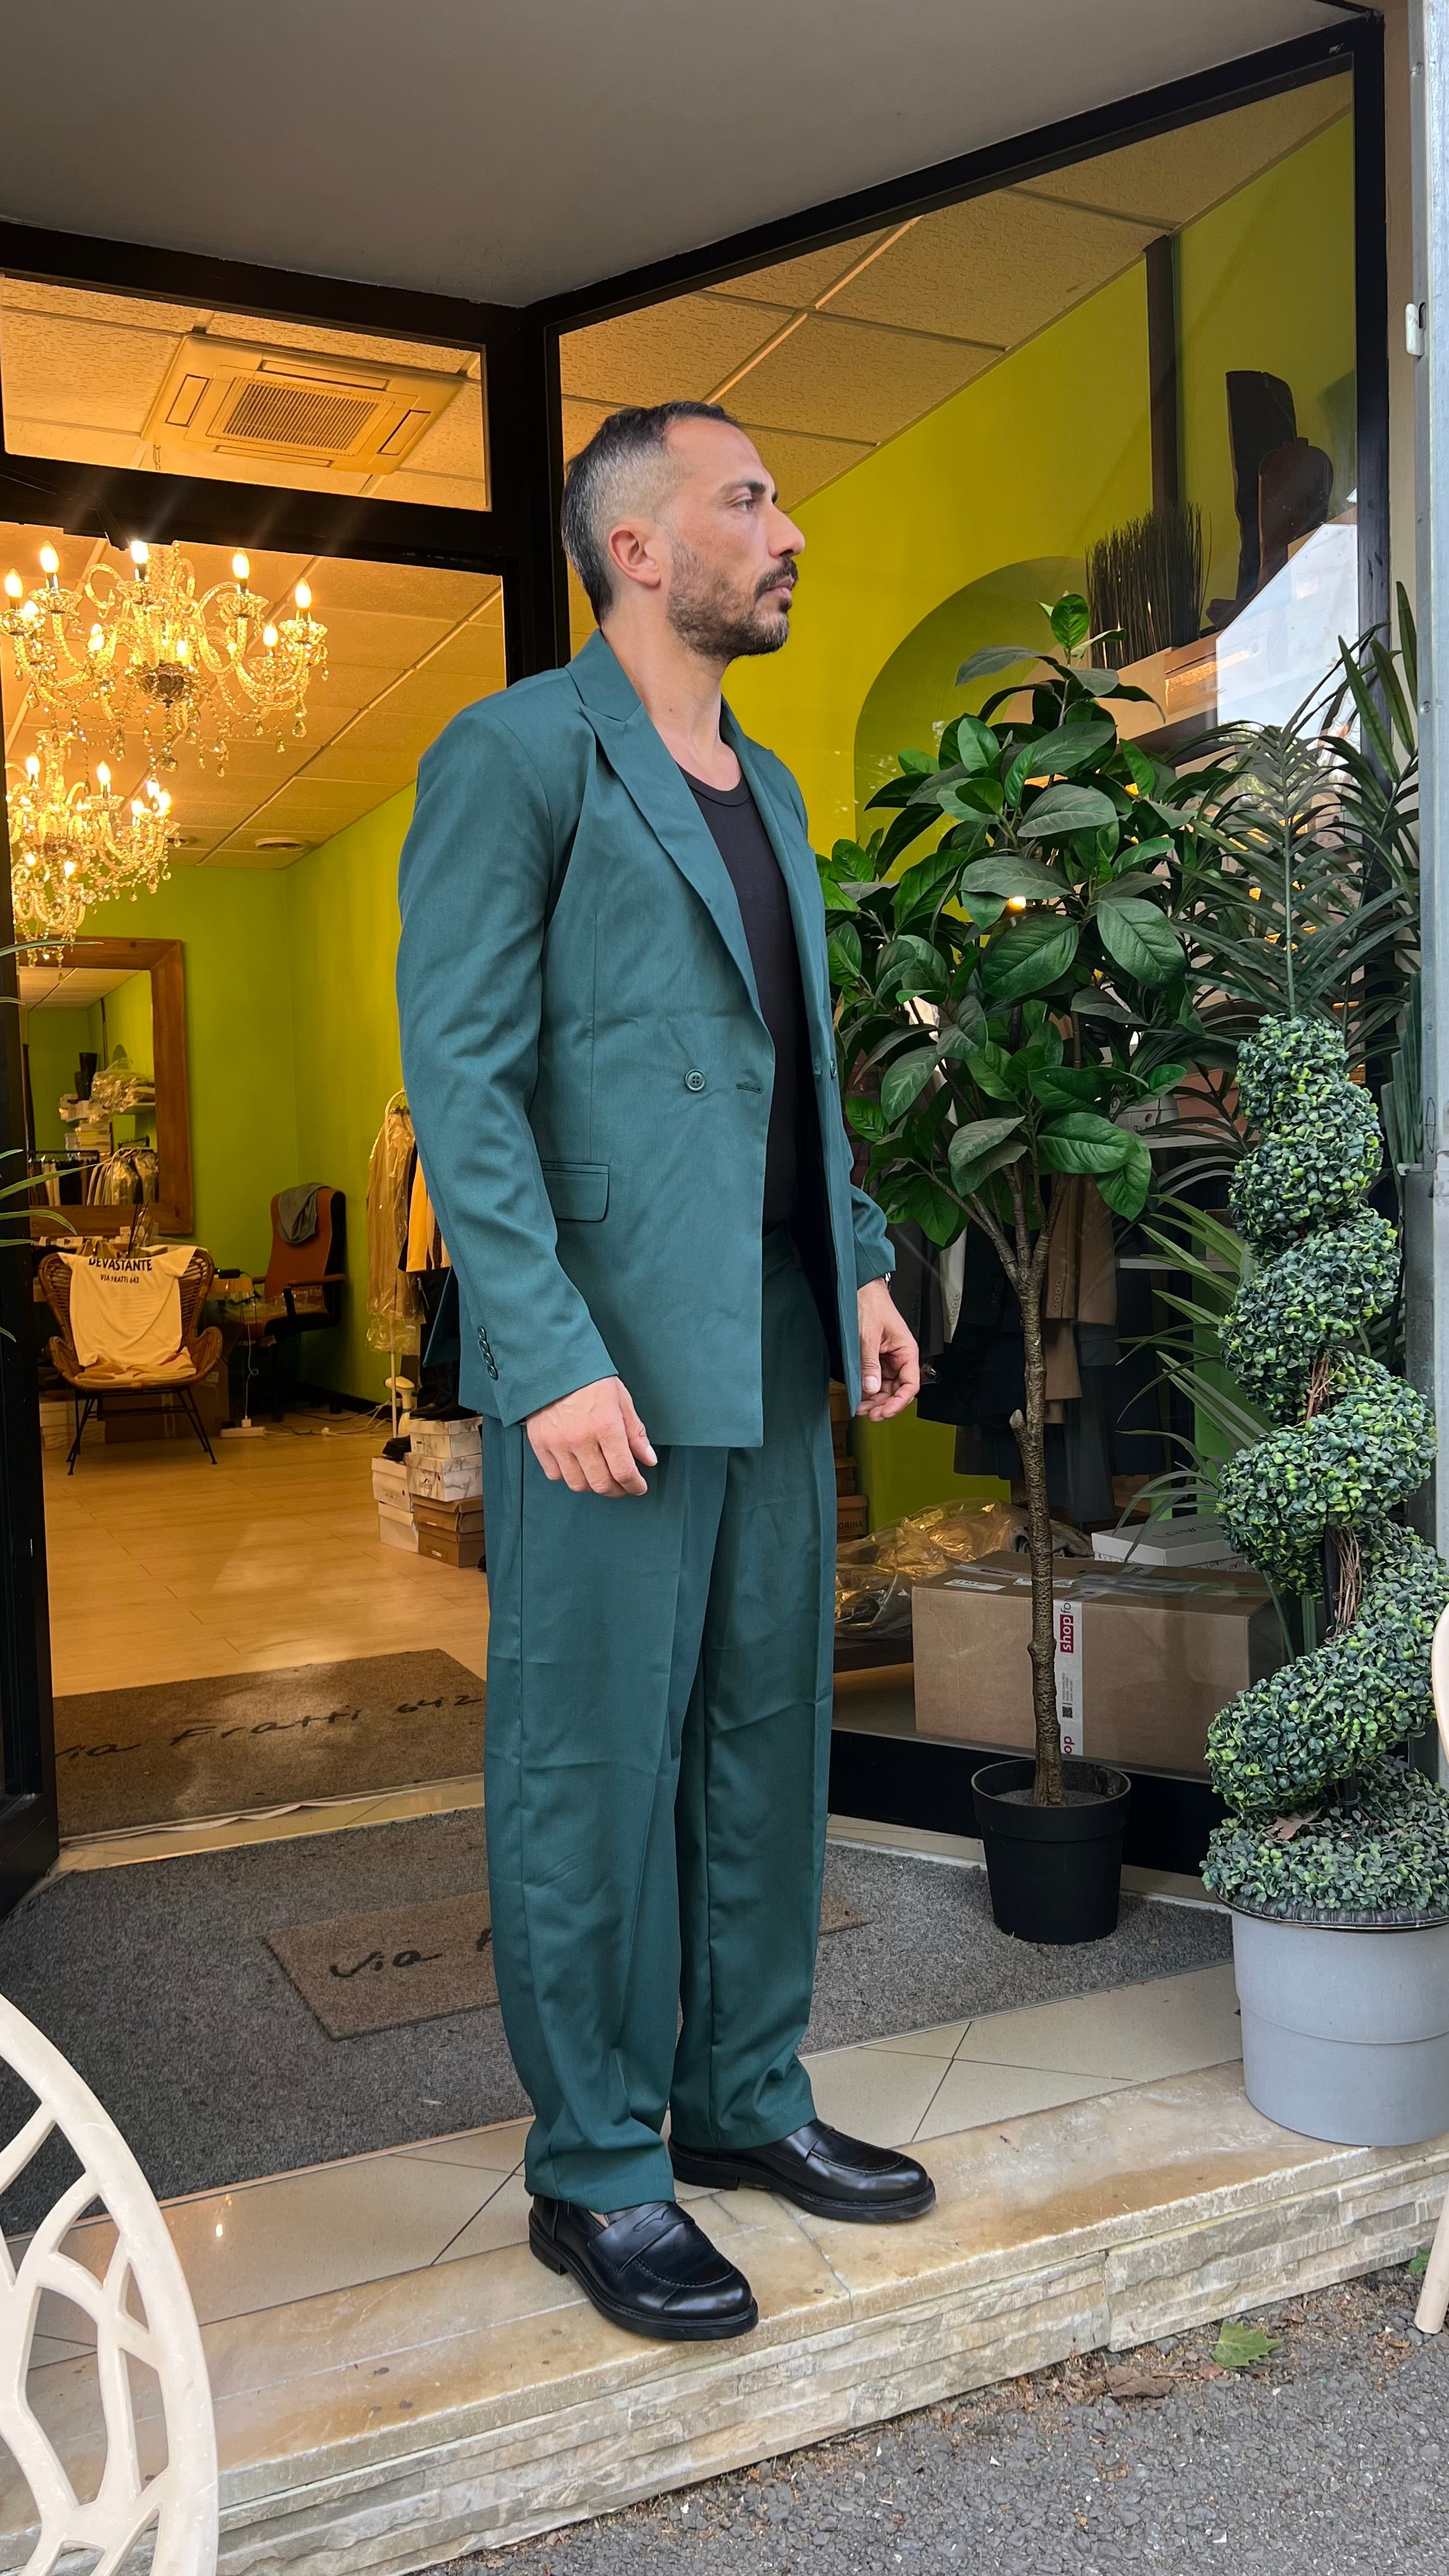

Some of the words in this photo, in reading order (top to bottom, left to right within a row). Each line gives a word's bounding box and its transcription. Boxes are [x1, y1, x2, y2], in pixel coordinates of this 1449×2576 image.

[89, 1258, 152, 1271] DEVASTANTE
[169, 1705, 362, 1746] Fratti
[396, 1695, 482, 1713] 642
[330, 1951, 443, 1979] Via
